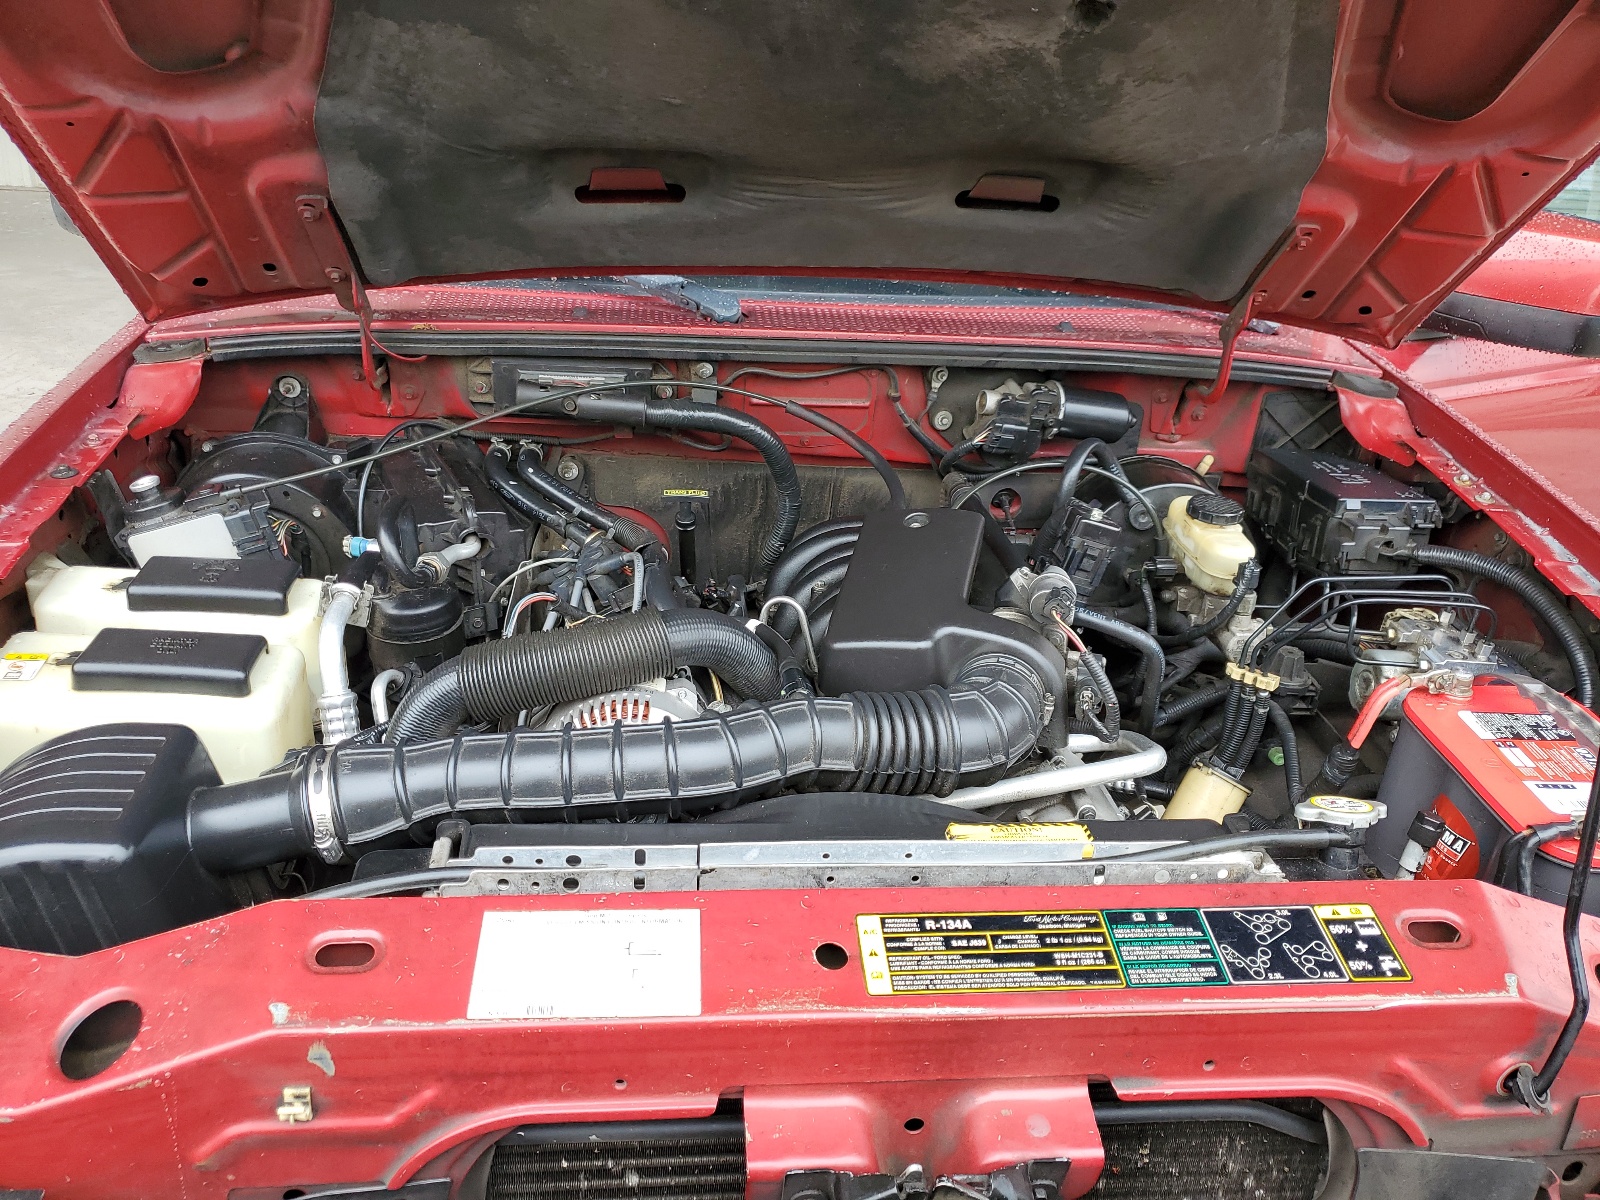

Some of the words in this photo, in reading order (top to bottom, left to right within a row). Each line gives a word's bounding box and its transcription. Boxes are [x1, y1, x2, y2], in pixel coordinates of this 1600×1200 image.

[1442, 831, 1464, 852] MA
[1023, 915, 1041, 923] Ford
[1041, 914, 1062, 924] Motor
[925, 919, 972, 930] R-134A
[1329, 924, 1352, 934] 50%
[1349, 961, 1373, 971] 50%
